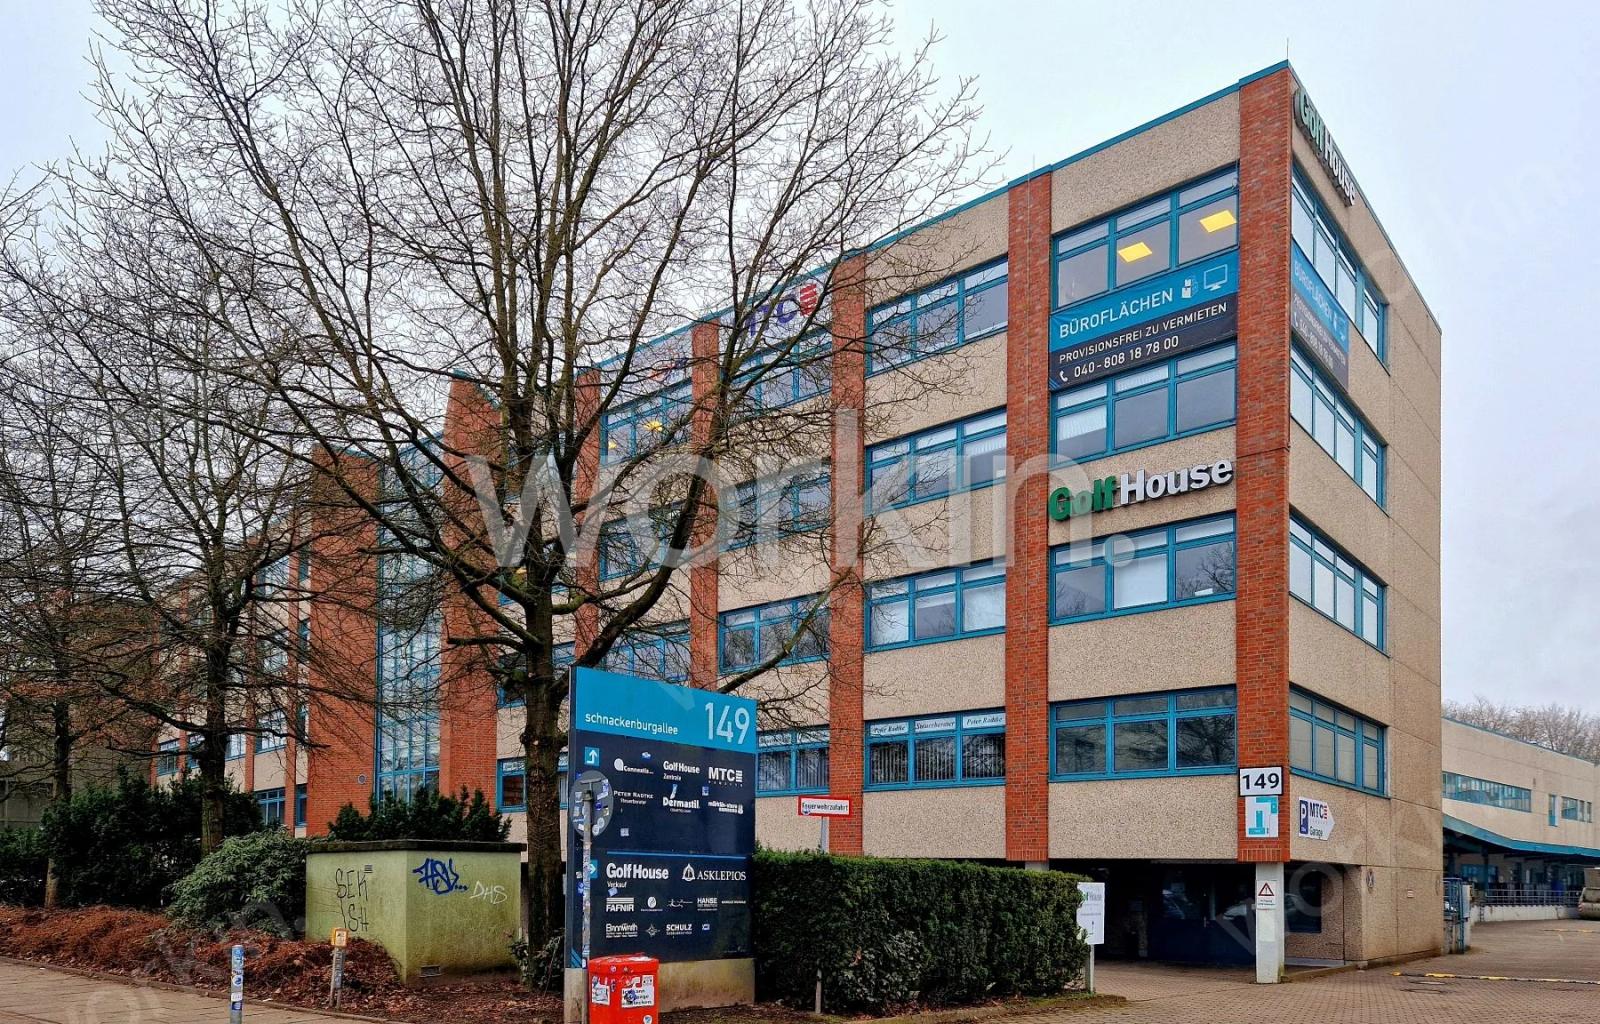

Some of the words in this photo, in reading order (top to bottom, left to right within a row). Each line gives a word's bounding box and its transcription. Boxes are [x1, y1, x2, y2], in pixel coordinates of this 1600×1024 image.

[1059, 287, 1173, 339] BÜROFLÄCHEN
[1059, 329, 1143, 364] PROVISIONSFREI
[1145, 323, 1159, 337] ZU
[1162, 302, 1227, 331] VERMIETEN
[1129, 346, 1142, 361] 18
[1145, 340, 1160, 356] 78
[1163, 335, 1179, 350] 00
[585, 712, 679, 735] schnackenburgallee
[704, 702, 750, 745] 149
[1242, 772, 1280, 790] 149
[606, 880, 628, 889] Verkauf
[697, 870, 747, 881] ASKLEPIOS
[605, 904, 635, 913] FAFNIR
[666, 923, 693, 932] SCHULZ
